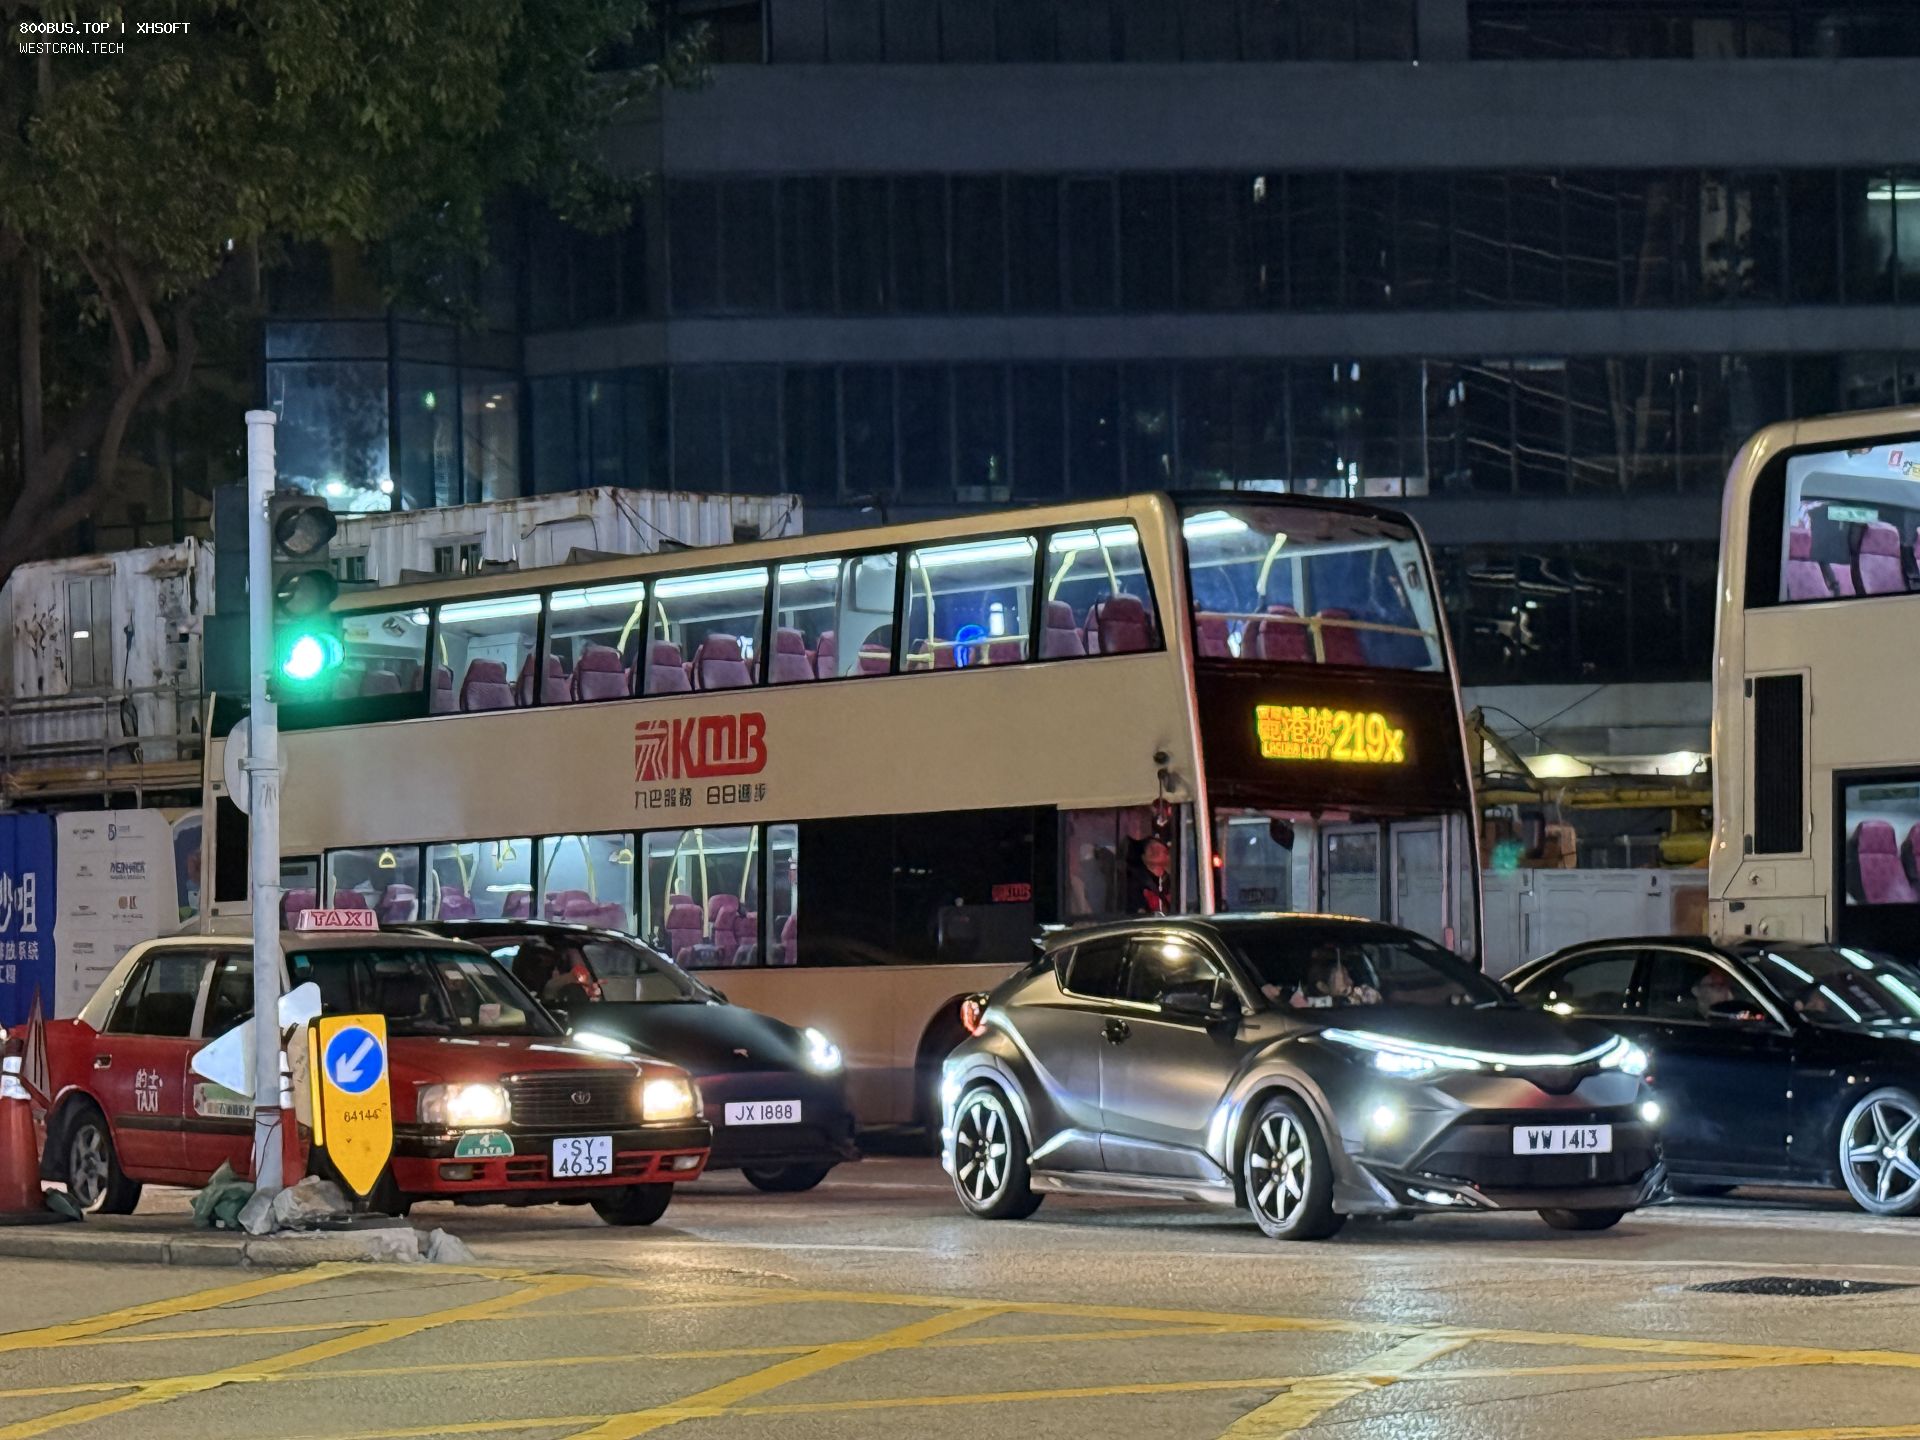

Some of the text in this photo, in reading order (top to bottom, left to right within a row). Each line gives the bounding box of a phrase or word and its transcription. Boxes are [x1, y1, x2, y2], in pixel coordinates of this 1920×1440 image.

[672, 712, 768, 779] KMB
[311, 911, 373, 927] TAXI
[135, 1090, 159, 1112] TAXI
[736, 1104, 793, 1121] JX 1888
[479, 1134, 491, 1147] 4
[571, 1139, 595, 1157] SY
[1562, 1129, 1598, 1149] 1413
[559, 1155, 607, 1175] 4635
